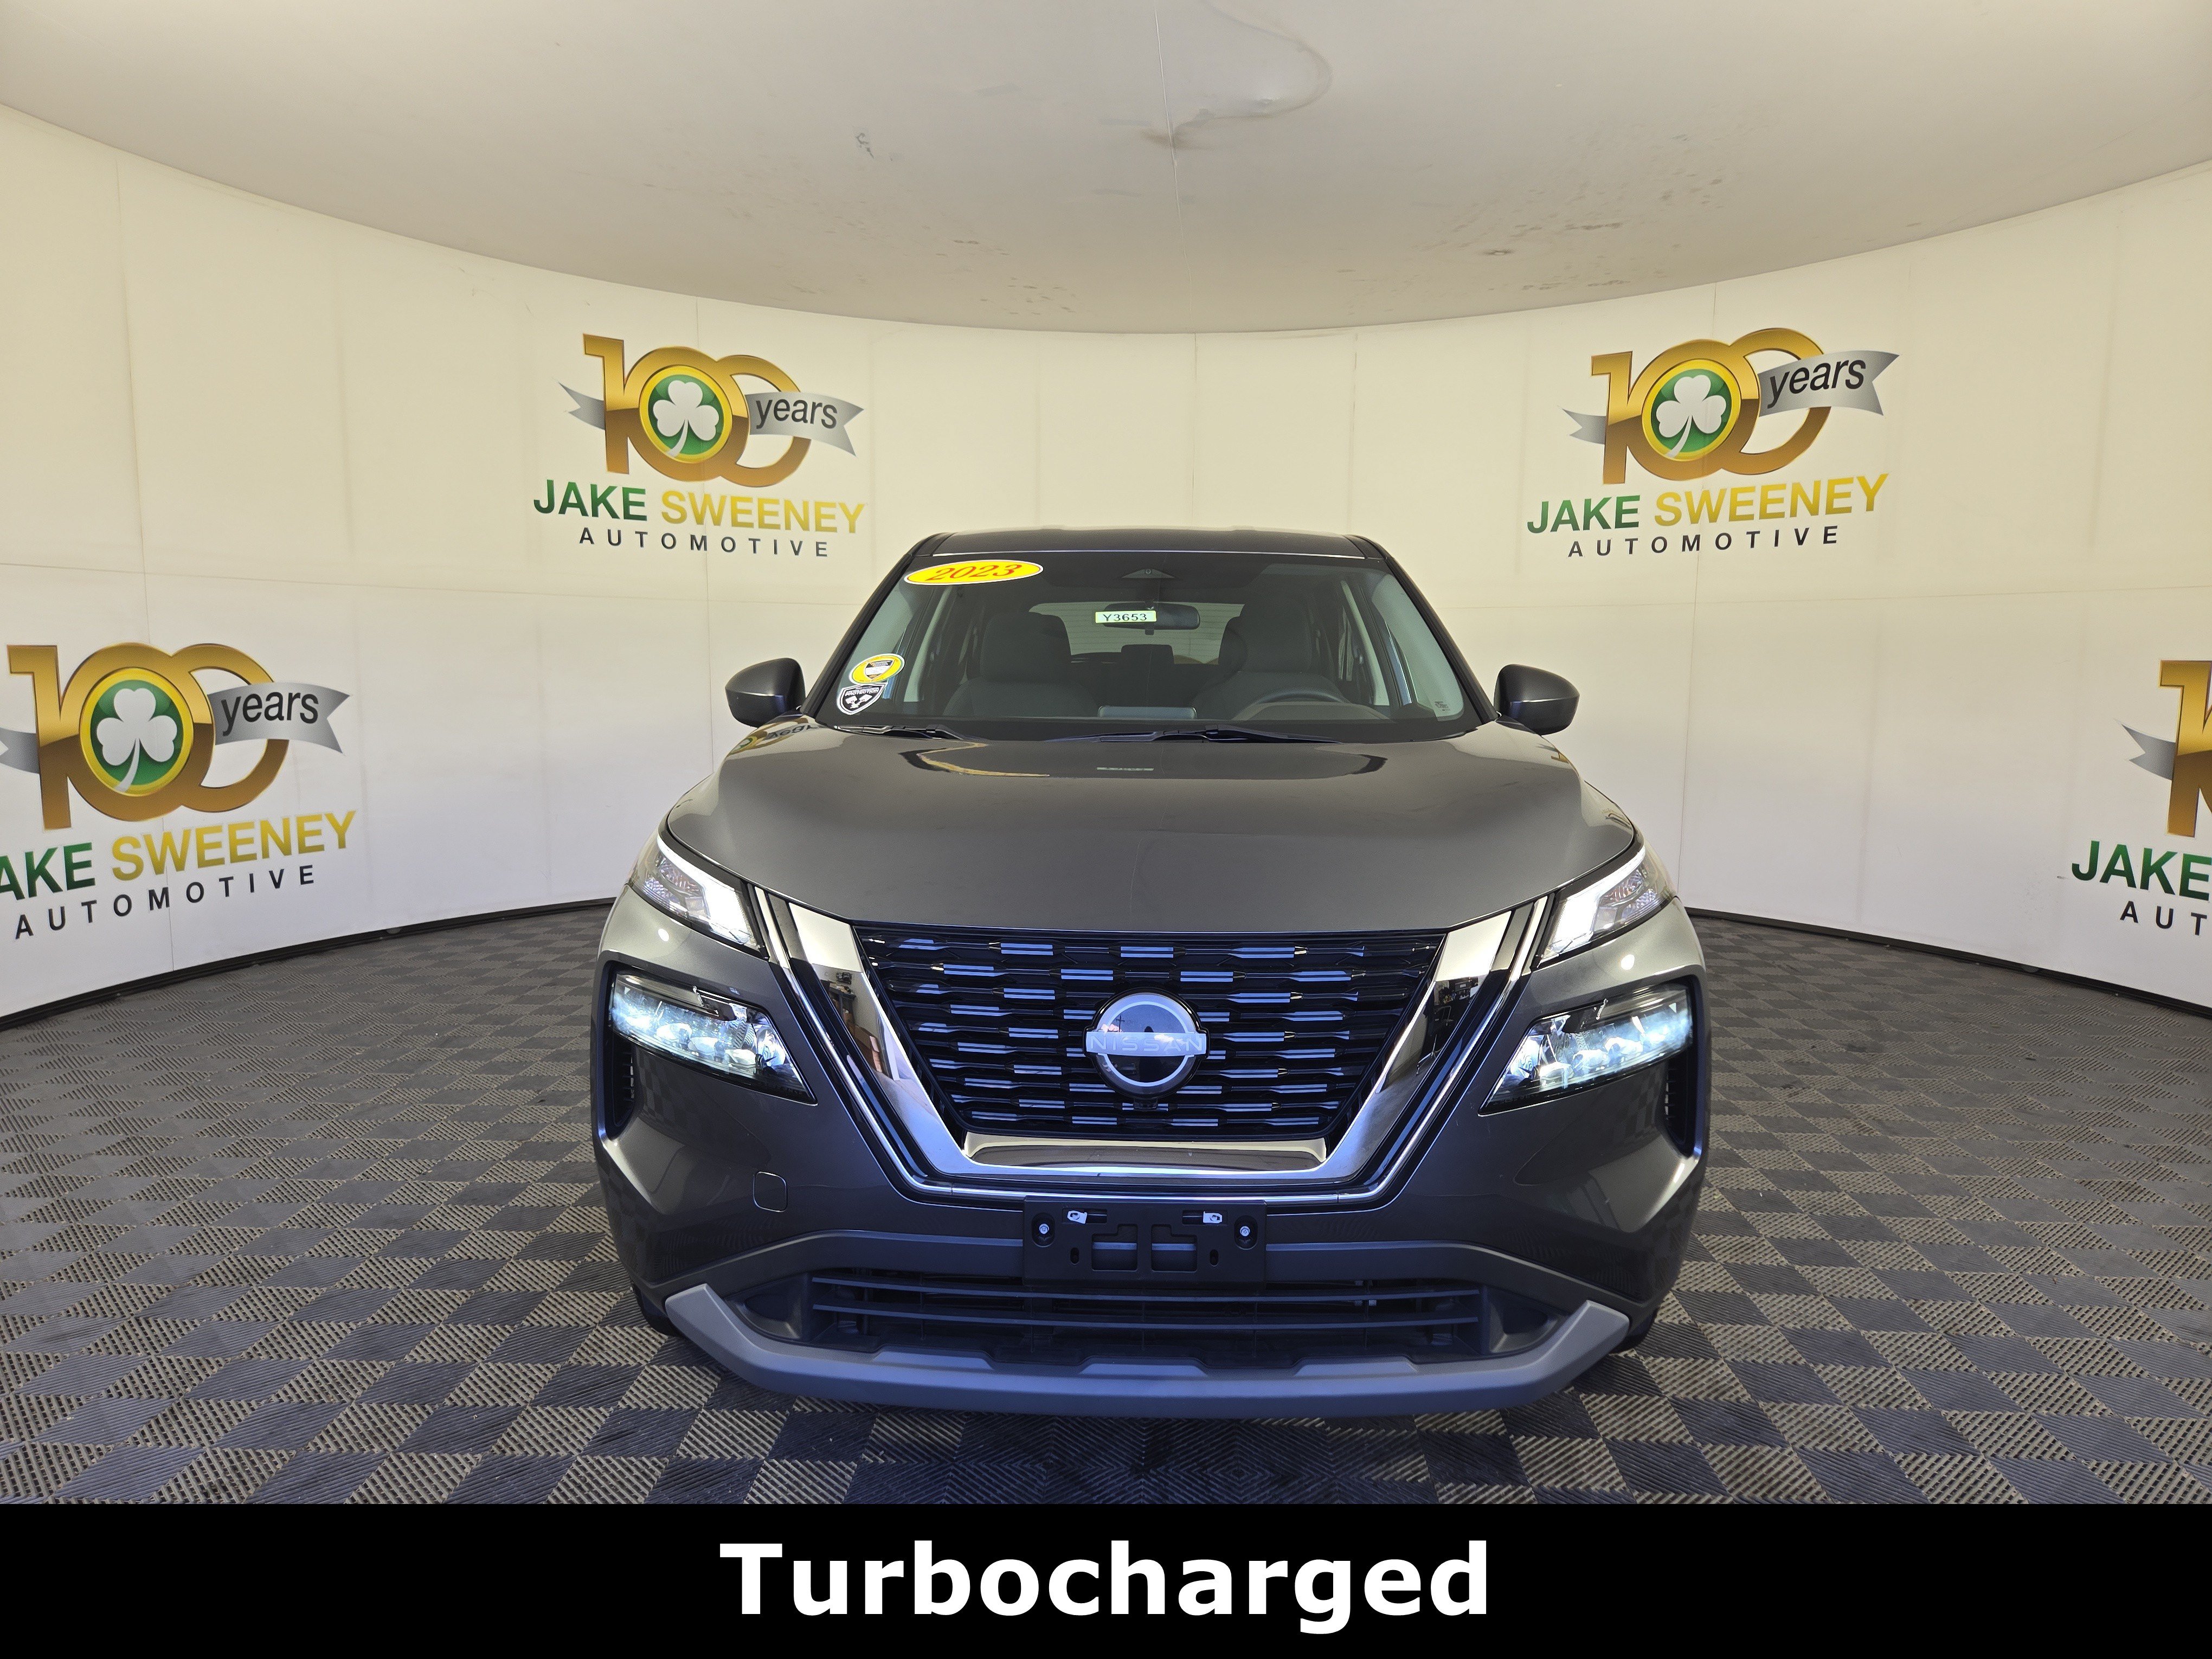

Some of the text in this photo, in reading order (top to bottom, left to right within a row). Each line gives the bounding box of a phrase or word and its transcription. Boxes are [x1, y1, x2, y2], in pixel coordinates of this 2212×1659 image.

[1590, 327, 1832, 485] 100
[1767, 358, 1867, 409] years
[582, 332, 812, 488] 100
[755, 398, 838, 430] years
[533, 479, 865, 535] JAKE SWEENEY
[1527, 473, 1889, 534] JAKE SWEENEY
[579, 527, 828, 557] AUTOMOTIVE
[1568, 525, 1838, 558] AUTOMOTIVE
[925, 564, 1022, 581] 2023
[1103, 613, 1148, 622] Y3653
[7, 641, 290, 831] 100
[221, 690, 319, 737] years
[111, 810, 357, 882] SWEENEY
[2072, 840, 2212, 901] JAKE
[15, 865, 315, 940] AUTOMOTIVE
[2120, 900, 2208, 936] AUT
[1090, 1035, 1203, 1052] NISSAN
